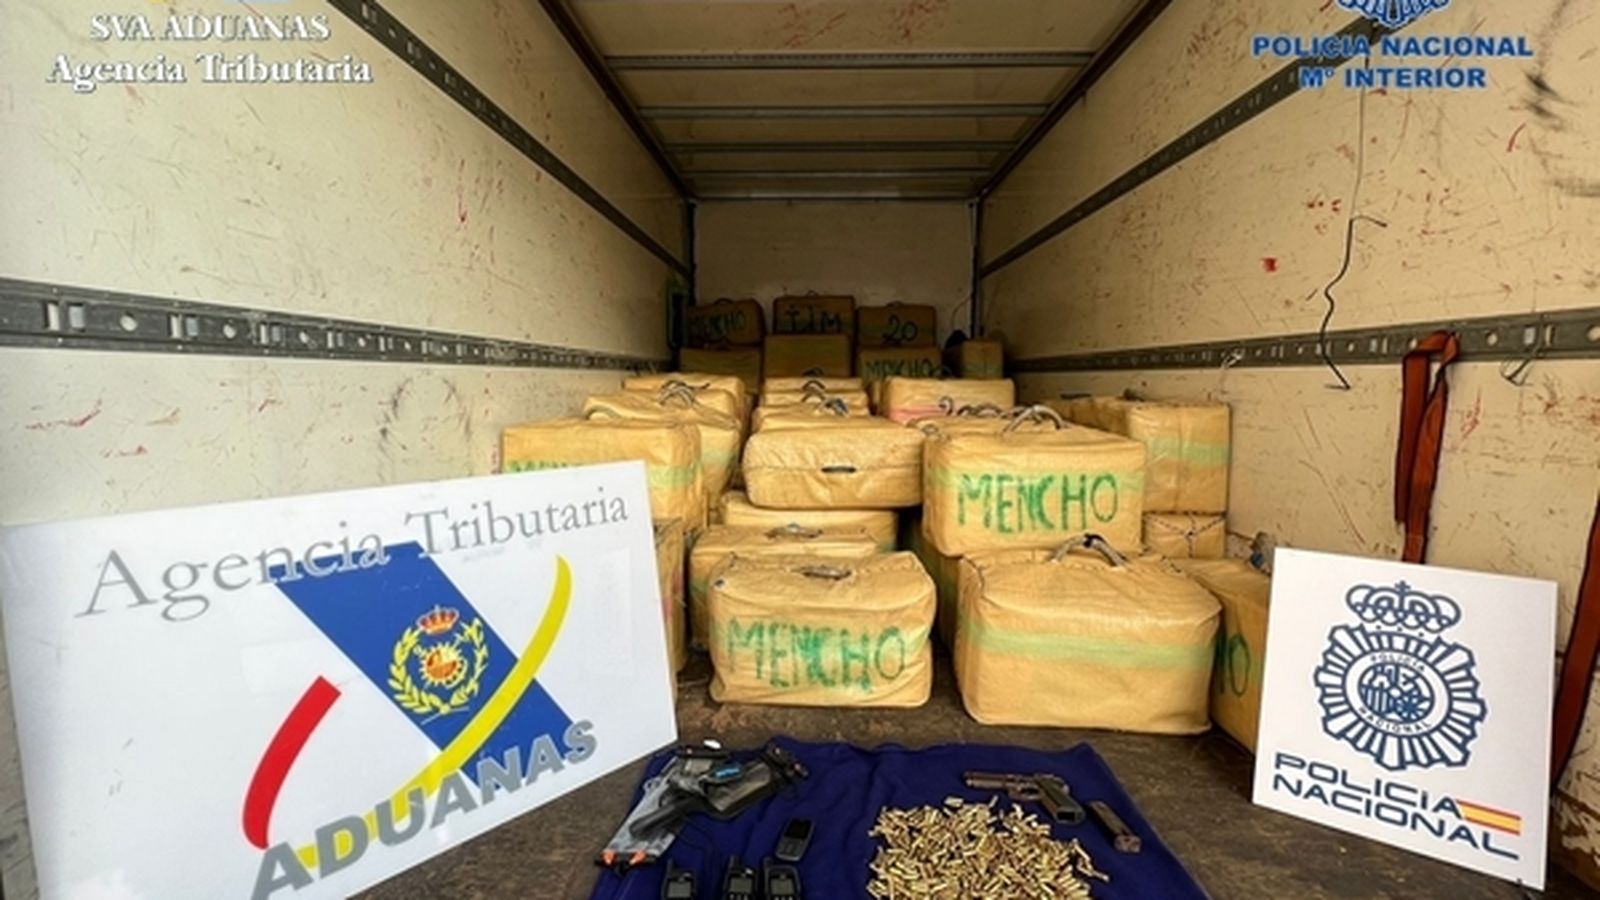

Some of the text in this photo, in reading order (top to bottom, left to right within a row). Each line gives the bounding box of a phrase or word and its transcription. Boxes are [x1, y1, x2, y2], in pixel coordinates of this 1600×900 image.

[883, 314, 918, 342] 20
[957, 472, 1119, 534] MENCHO
[73, 486, 629, 623] Agencia Tributaria
[727, 616, 906, 694] MENCHO
[1370, 654, 1425, 672] POLICIA
[1358, 706, 1432, 736] NACIONAL
[250, 720, 598, 900] ADUANAS
[1273, 773, 1519, 861] NACIONAL
[1275, 752, 1463, 820] POLICIA
